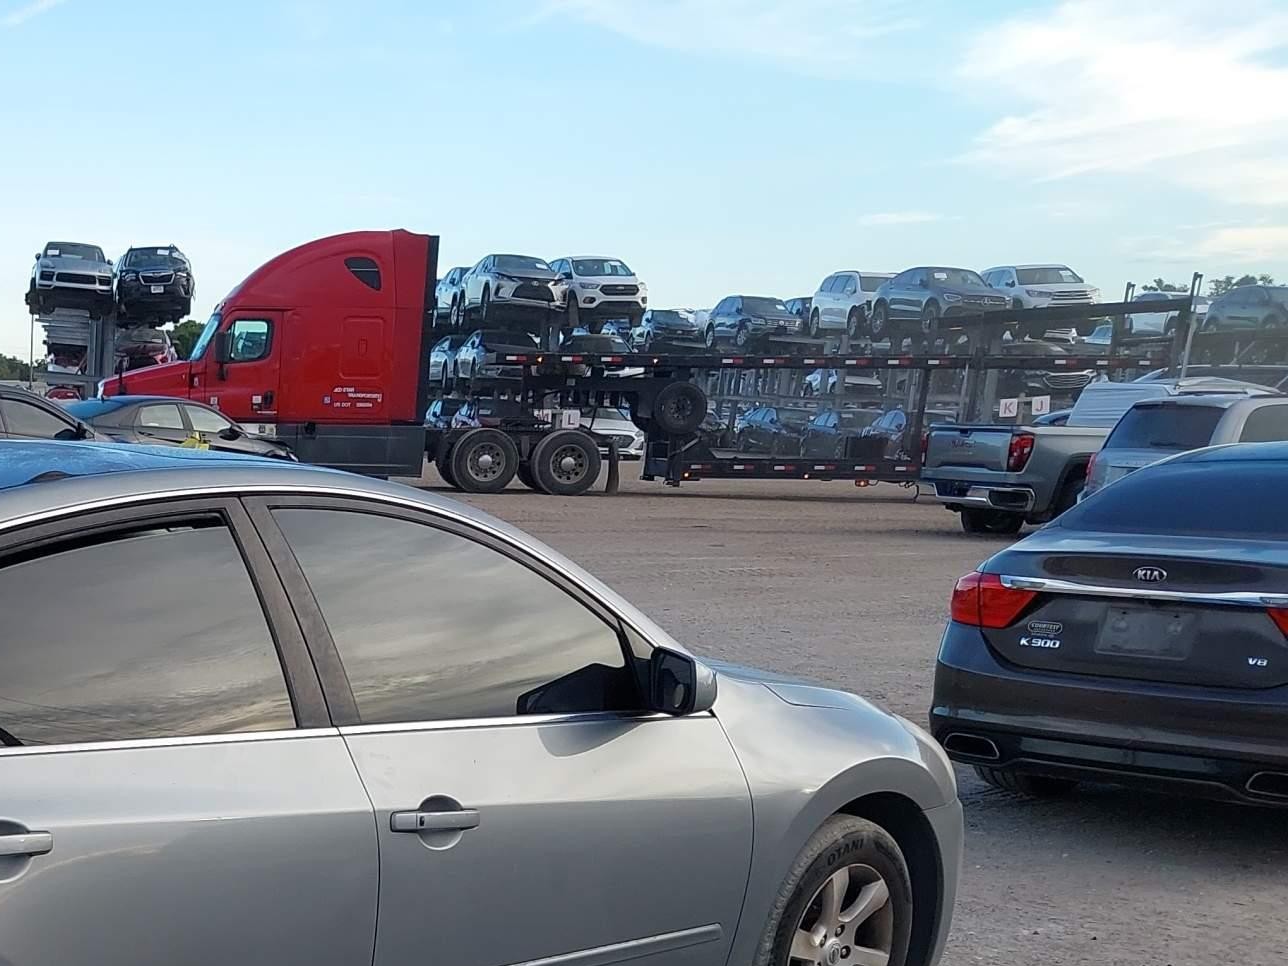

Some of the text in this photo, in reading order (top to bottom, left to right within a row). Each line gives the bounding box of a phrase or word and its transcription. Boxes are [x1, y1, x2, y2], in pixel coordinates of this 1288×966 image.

[1003, 402, 1013, 415] K
[1035, 401, 1044, 412] J
[567, 413, 576, 426] L
[1137, 569, 1160, 581] KIA
[1247, 657, 1268, 667] V8
[827, 838, 864, 866] OTANI
